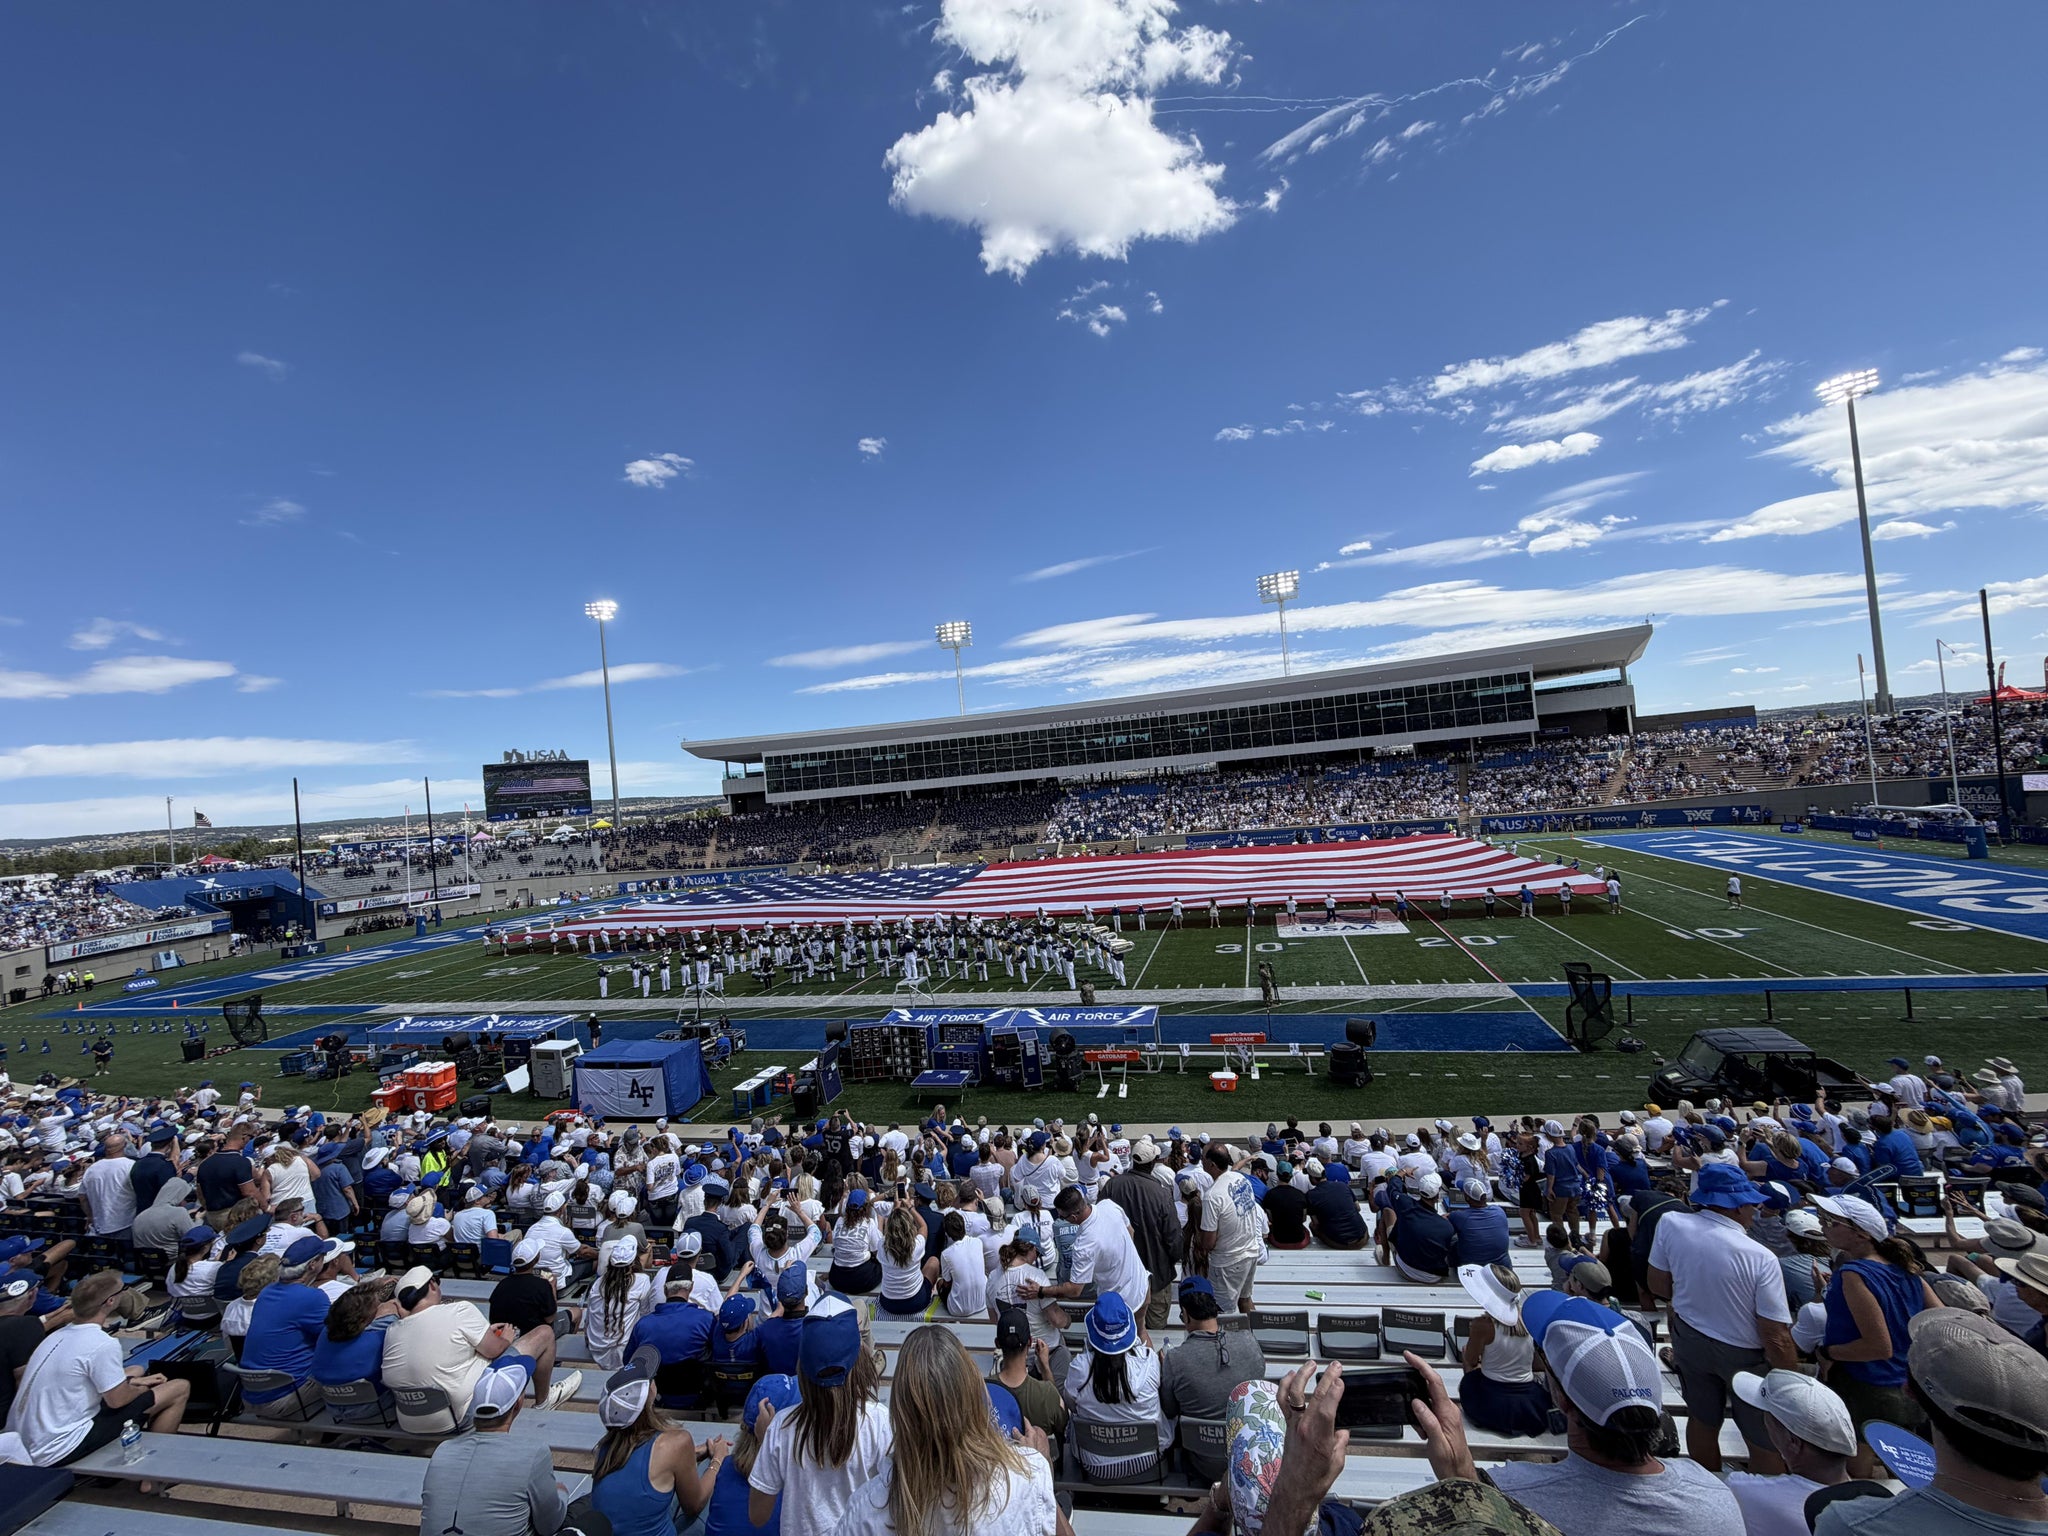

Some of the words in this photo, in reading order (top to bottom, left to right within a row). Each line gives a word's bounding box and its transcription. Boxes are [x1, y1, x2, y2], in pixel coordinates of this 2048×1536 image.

[1049, 720, 1084, 728] KUCERA
[1089, 715, 1124, 724] LEGACY
[1129, 710, 1165, 719] CENTER
[527, 749, 569, 761] USAA
[1948, 794, 2001, 802] FEDERAL
[1641, 811, 1657, 825] AF
[1745, 806, 1760, 822] AF
[1236, 833, 1247, 844] AF
[360, 843, 378, 851] AIR
[381, 839, 419, 851] FORCE
[694, 876, 717, 885] USAA
[368, 899, 400, 907] COMMAND
[158, 928, 176, 936] FIRST
[1302, 923, 1379, 933] USAA
[1665, 927, 1747, 940] 10
[157, 930, 194, 941] COMMAND
[83, 940, 102, 949] FIRST
[1415, 935, 1500, 948] 20
[82, 943, 119, 954] COMMAND
[307, 945, 318, 954] AF
[1215, 942, 1284, 954] 30
[250, 949, 421, 981] AIR
[138, 979, 157, 987] USAA
[915, 1014, 938, 1023] AIR
[942, 1013, 985, 1023] FORCE
[1048, 1012, 1071, 1021] AIR
[1075, 1012, 1124, 1021] FORCE
[1220, 1081, 1227, 1089] G
[628, 1078, 654, 1107] AF
[375, 1099, 384, 1109] G
[414, 1092, 426, 1109] G
[825, 1139, 841, 1154] 19
[1059, 1226, 1070, 1236] AIR
[1262, 1314, 1296, 1323] RENTED
[1395, 1312, 1432, 1323] RENTED
[1612, 1387, 1652, 1398] FALCONS
[1089, 1424, 1138, 1437] RENTED
[1199, 1424, 1224, 1437] REN
[1091, 1435, 1107, 1443] LEAVE
[1116, 1435, 1138, 1444] STADIUM
[1200, 1436, 1215, 1444] LEAVE
[1878, 1439, 1900, 1459] AF
